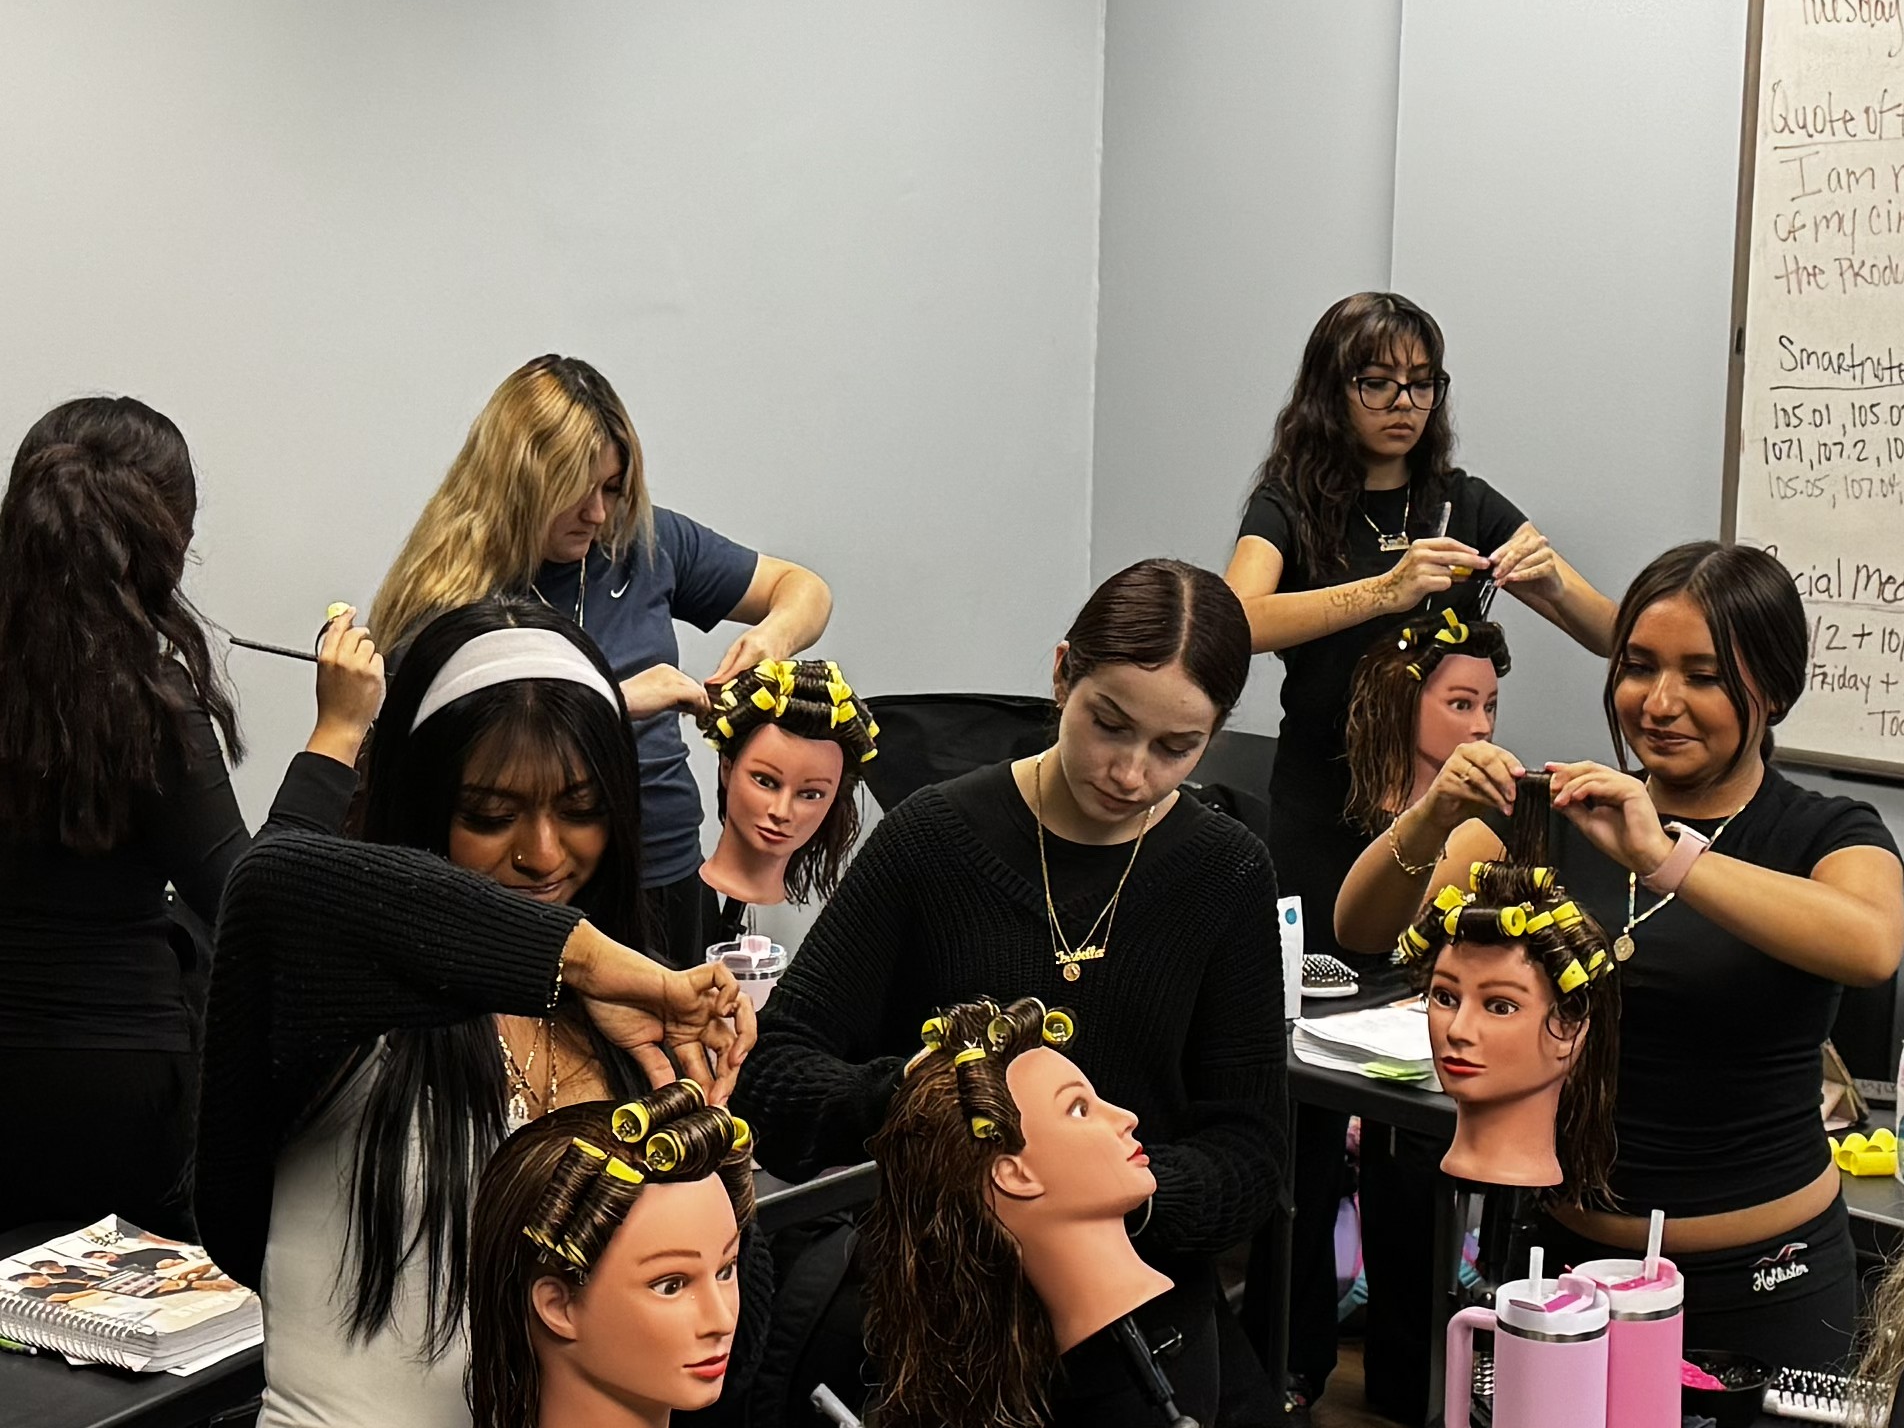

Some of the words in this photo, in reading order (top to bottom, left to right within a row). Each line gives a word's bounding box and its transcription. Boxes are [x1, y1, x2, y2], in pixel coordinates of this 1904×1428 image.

[1770, 79, 1858, 139] Quote
[1779, 151, 1823, 202] I
[1827, 164, 1876, 192] am
[1813, 200, 1859, 254] my
[1773, 255, 1827, 297] the
[1808, 662, 1872, 704] Friday
[1752, 1261, 1809, 1292] Hollister
